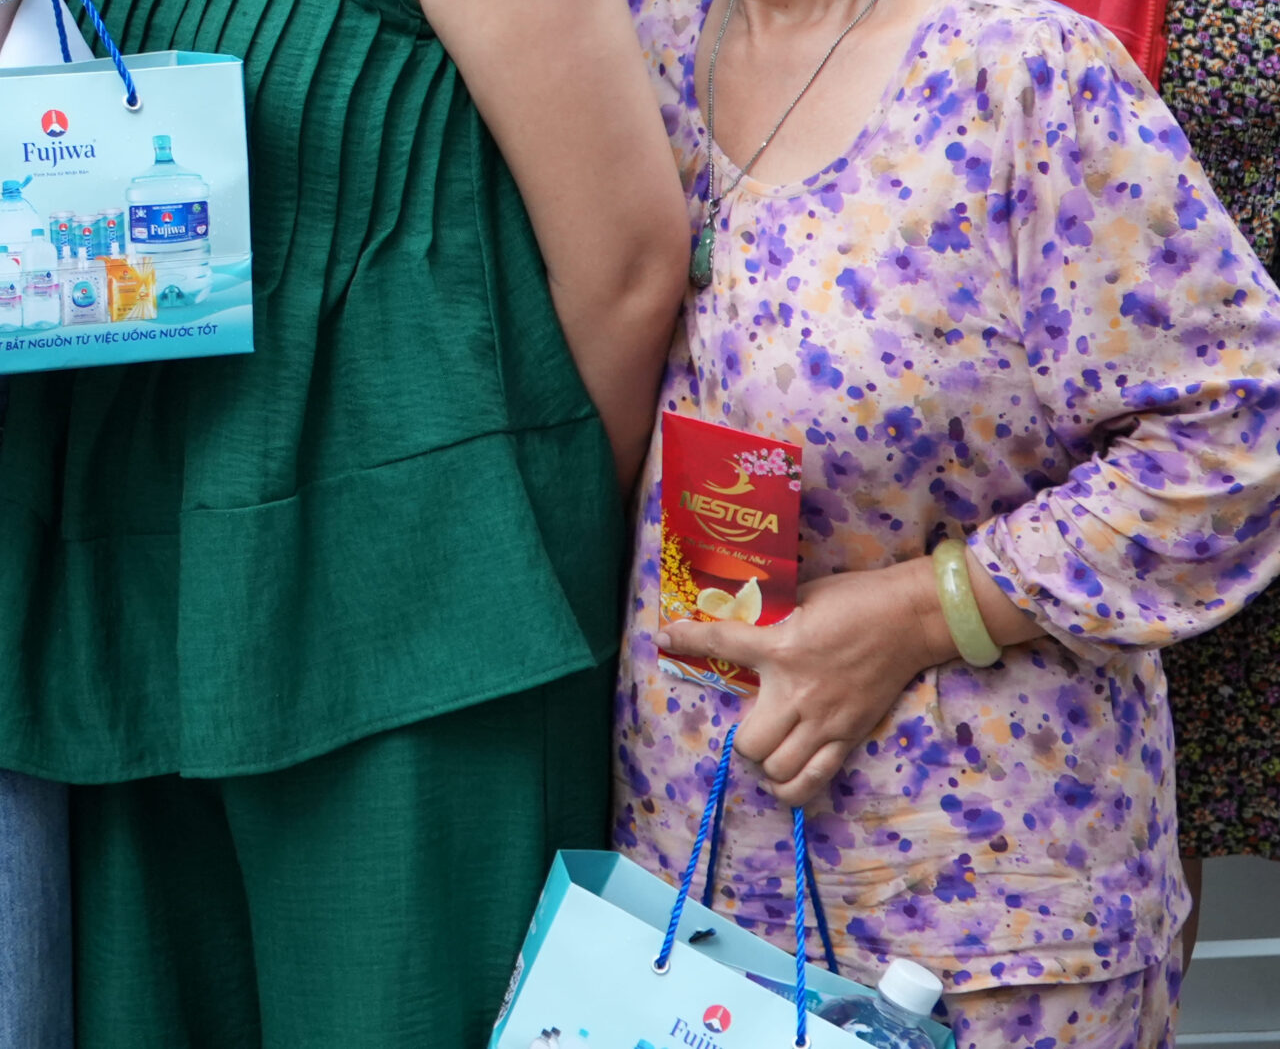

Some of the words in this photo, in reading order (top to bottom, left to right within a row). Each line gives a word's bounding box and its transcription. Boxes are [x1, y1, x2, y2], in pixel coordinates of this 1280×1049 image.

[22, 140, 96, 168] Fujiwa
[150, 224, 186, 238] Fujiwa
[5, 336, 26, 351] BẮT
[28, 334, 72, 350] NGUỒN
[75, 333, 91, 346] TỪ
[94, 331, 119, 345] VIỆC
[122, 327, 156, 342] UỐNG
[159, 325, 194, 339] NƯỚC
[197, 322, 218, 336] TỐT
[680, 491, 779, 534] NESTGIA
